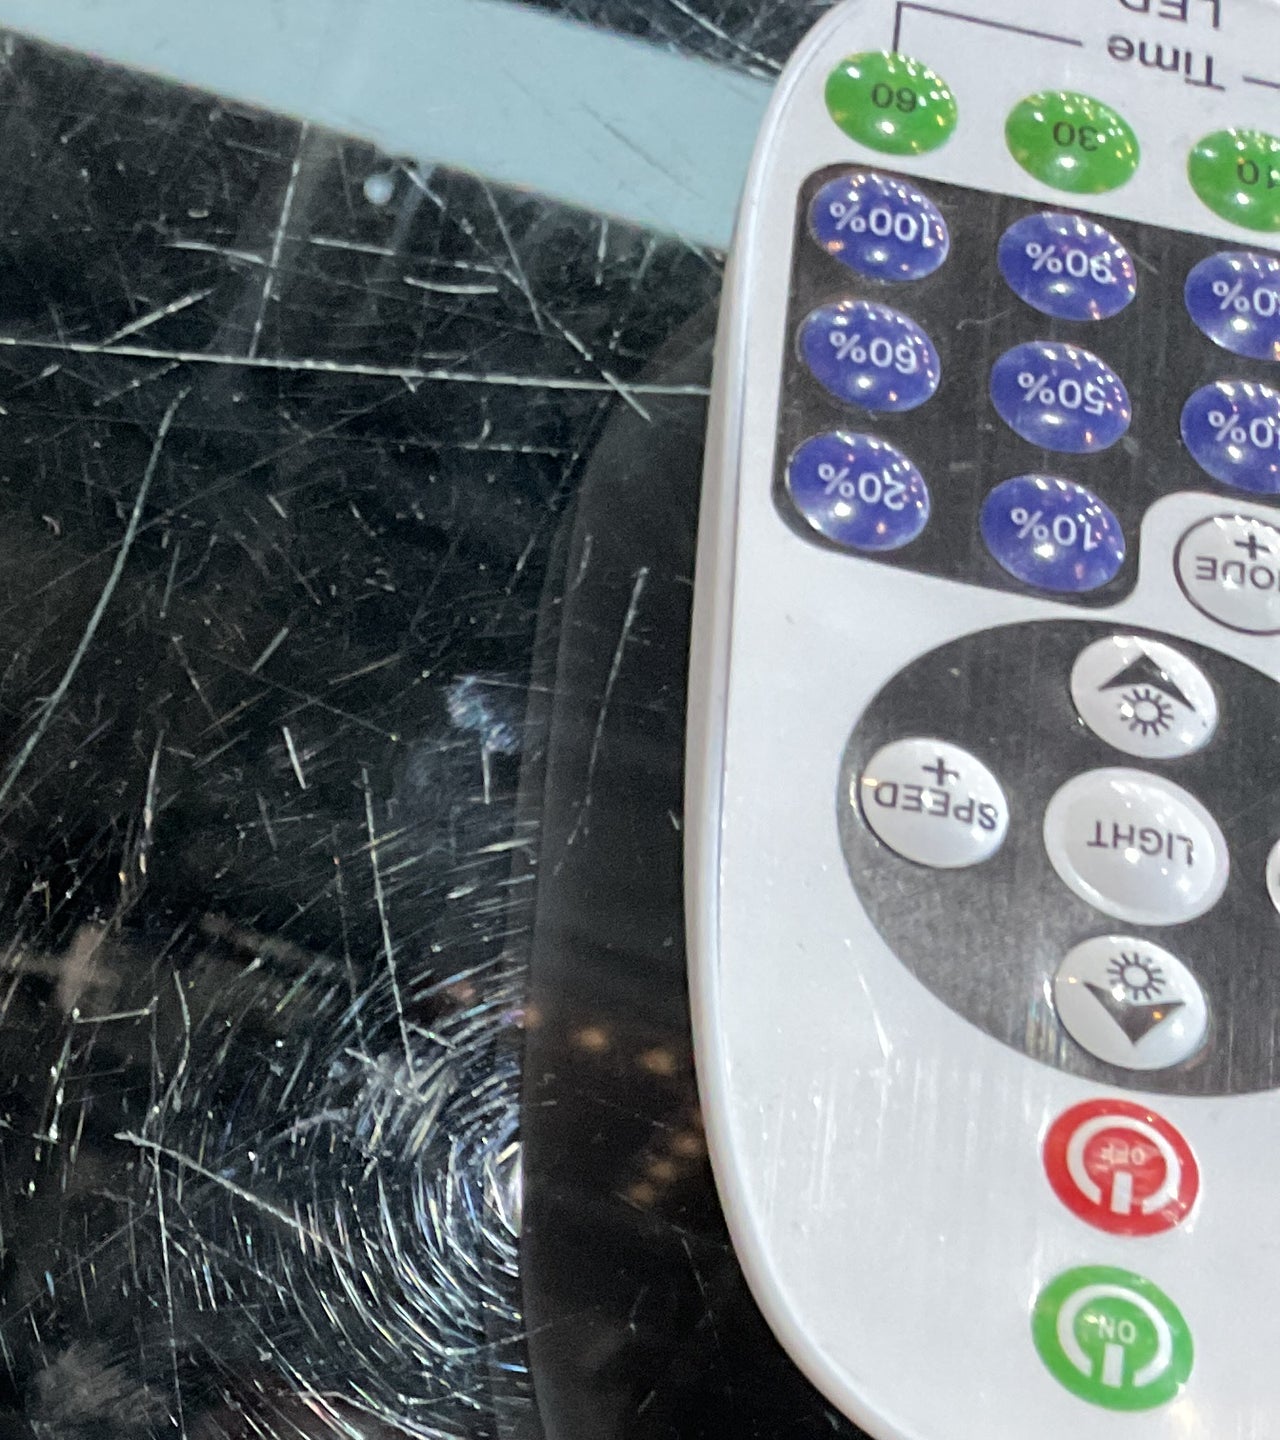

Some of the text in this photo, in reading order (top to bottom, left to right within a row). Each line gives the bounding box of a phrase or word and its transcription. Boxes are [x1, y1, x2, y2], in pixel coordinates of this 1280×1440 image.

[1107, 34, 1226, 92] Time
[871, 81, 917, 114] 60
[1052, 119, 1100, 153] 30
[829, 201, 934, 248] 100%
[1025, 241, 1115, 285] 90%
[829, 331, 918, 375] 60%
[1017, 371, 1106, 415] 50%
[817, 462, 907, 512] 20%
[1011, 506, 1099, 552] 10%
[1195, 555, 1280, 593] ODE
[873, 780, 1000, 832] SPEED
[1086, 818, 1195, 867] LIGHT
[1097, 1317, 1137, 1345] ON
